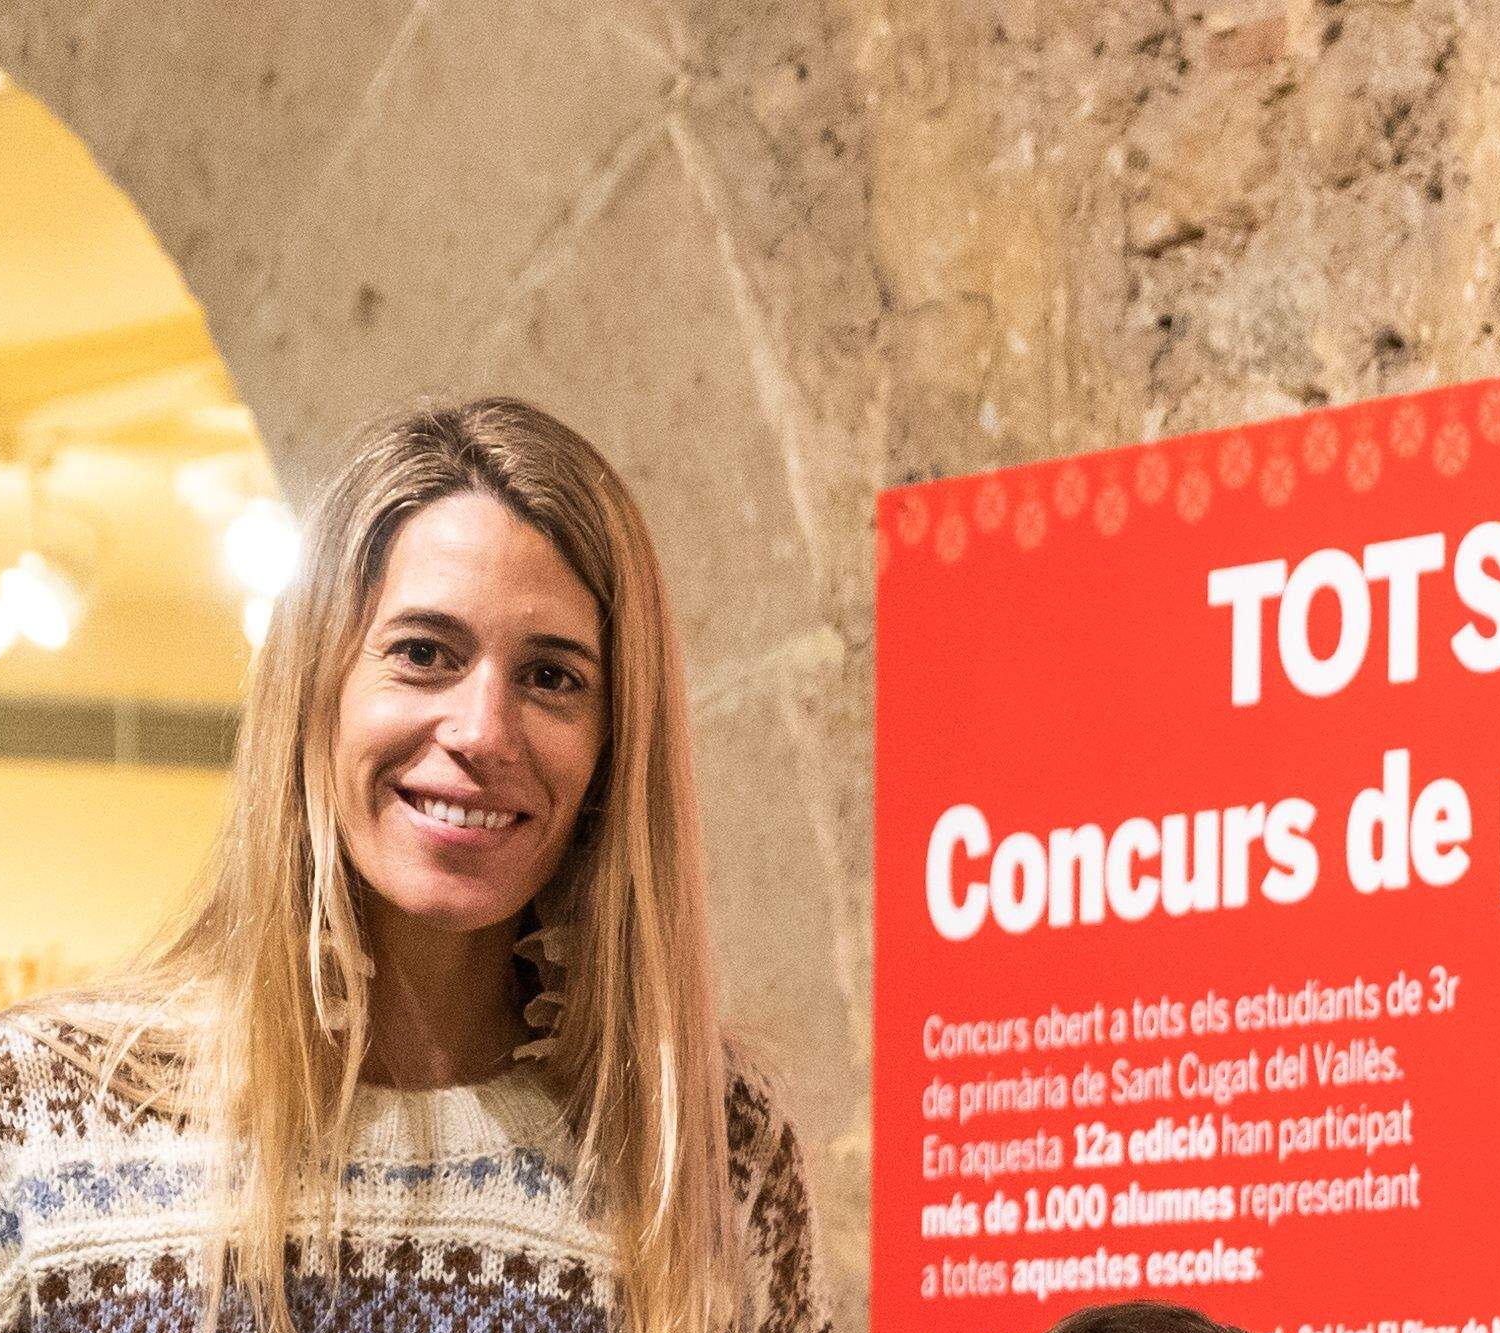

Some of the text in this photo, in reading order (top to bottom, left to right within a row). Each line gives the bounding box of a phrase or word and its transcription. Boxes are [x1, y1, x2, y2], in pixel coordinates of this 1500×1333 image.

[1209, 536, 1443, 706] TOT
[925, 796, 1317, 938] Concurs
[1346, 751, 1469, 894] de
[922, 965, 1460, 1060] Concurs obert tots els estudiants de 3r
[922, 1037, 1404, 1124] de primària de Sant Cugat del Vallès.
[922, 1100, 1414, 1182] En aquesta 12a edició han participat
[921, 1165, 1421, 1239] més de 1.000 alumnes representant
[942, 1240, 1262, 1301] totes aquestes escoles:
